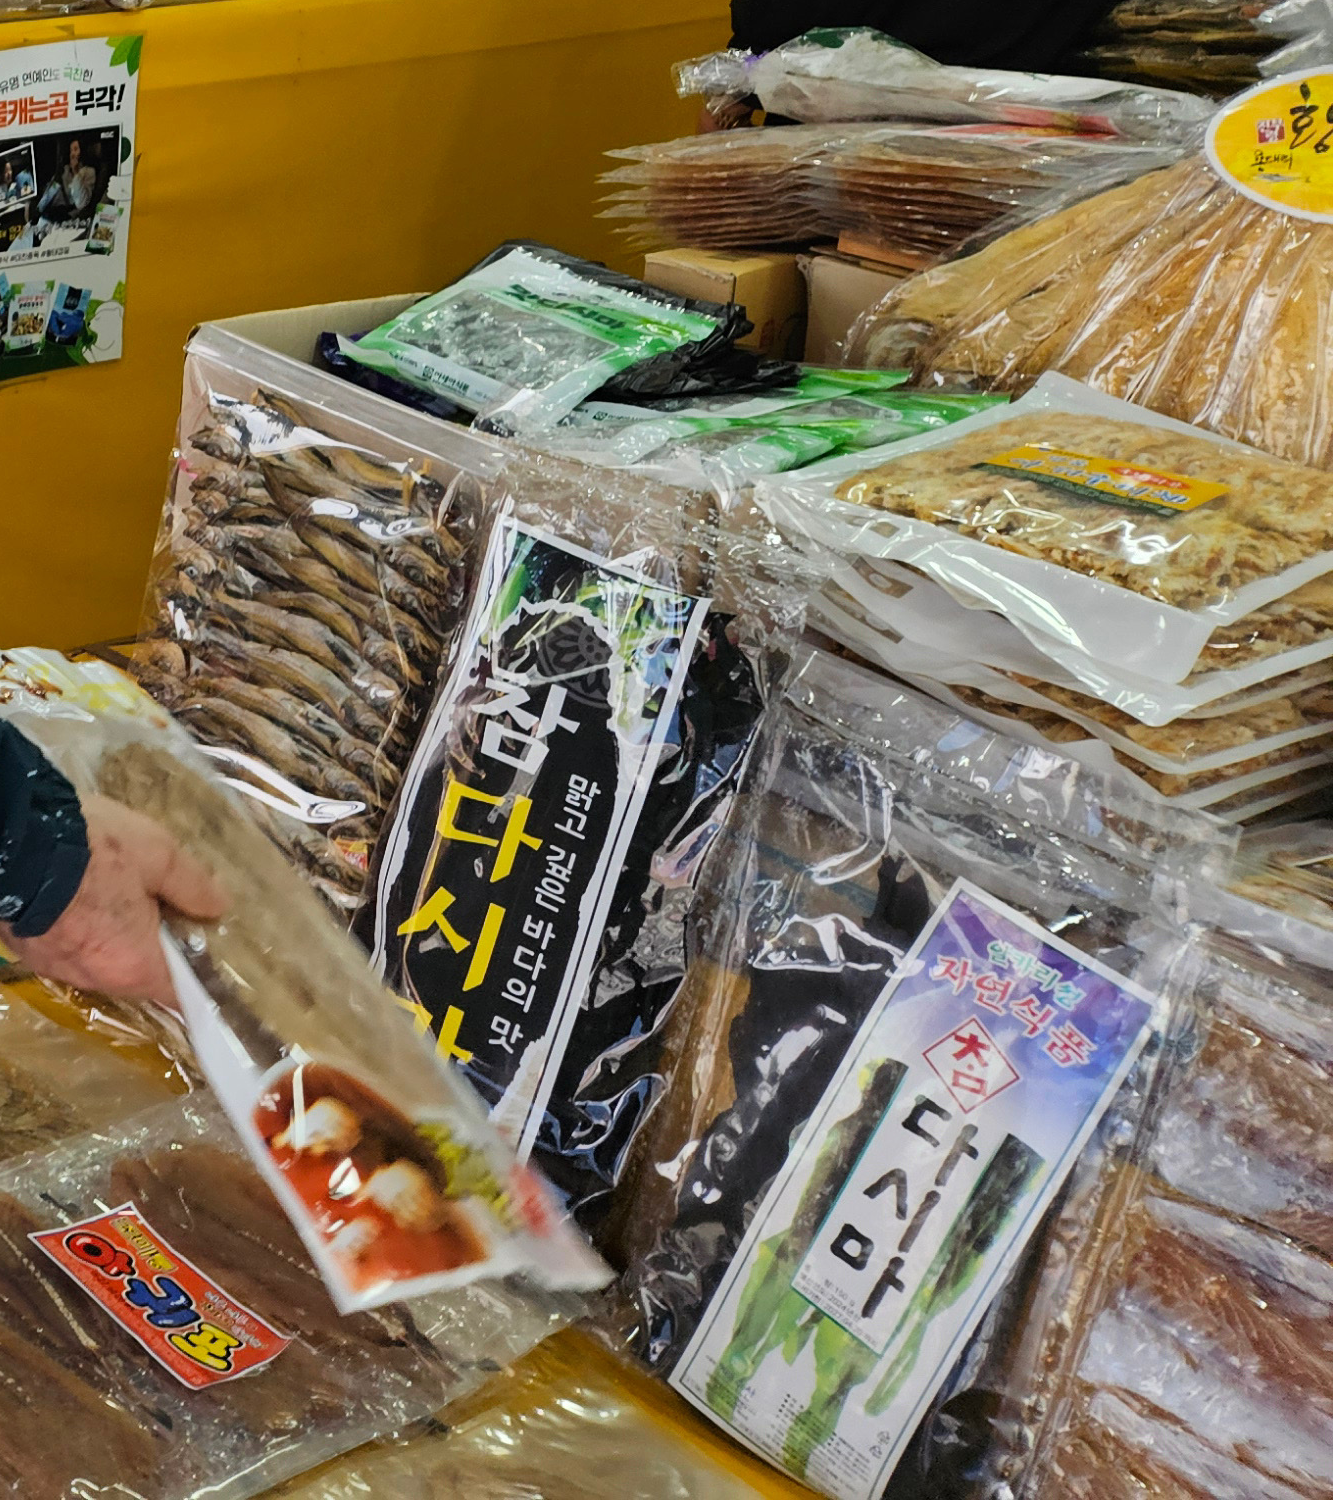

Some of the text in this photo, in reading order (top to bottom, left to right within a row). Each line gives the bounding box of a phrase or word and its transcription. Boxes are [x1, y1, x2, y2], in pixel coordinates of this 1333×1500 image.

[75, 83, 126, 116] 부각!
[555, 773, 603, 841] 맑고
[534, 844, 578, 915] 깊은
[500, 914, 557, 1014] 바다의
[487, 1014, 524, 1054] 맛
[932, 955, 1098, 1068] 자연식품
[829, 1095, 980, 1320] 다시마
